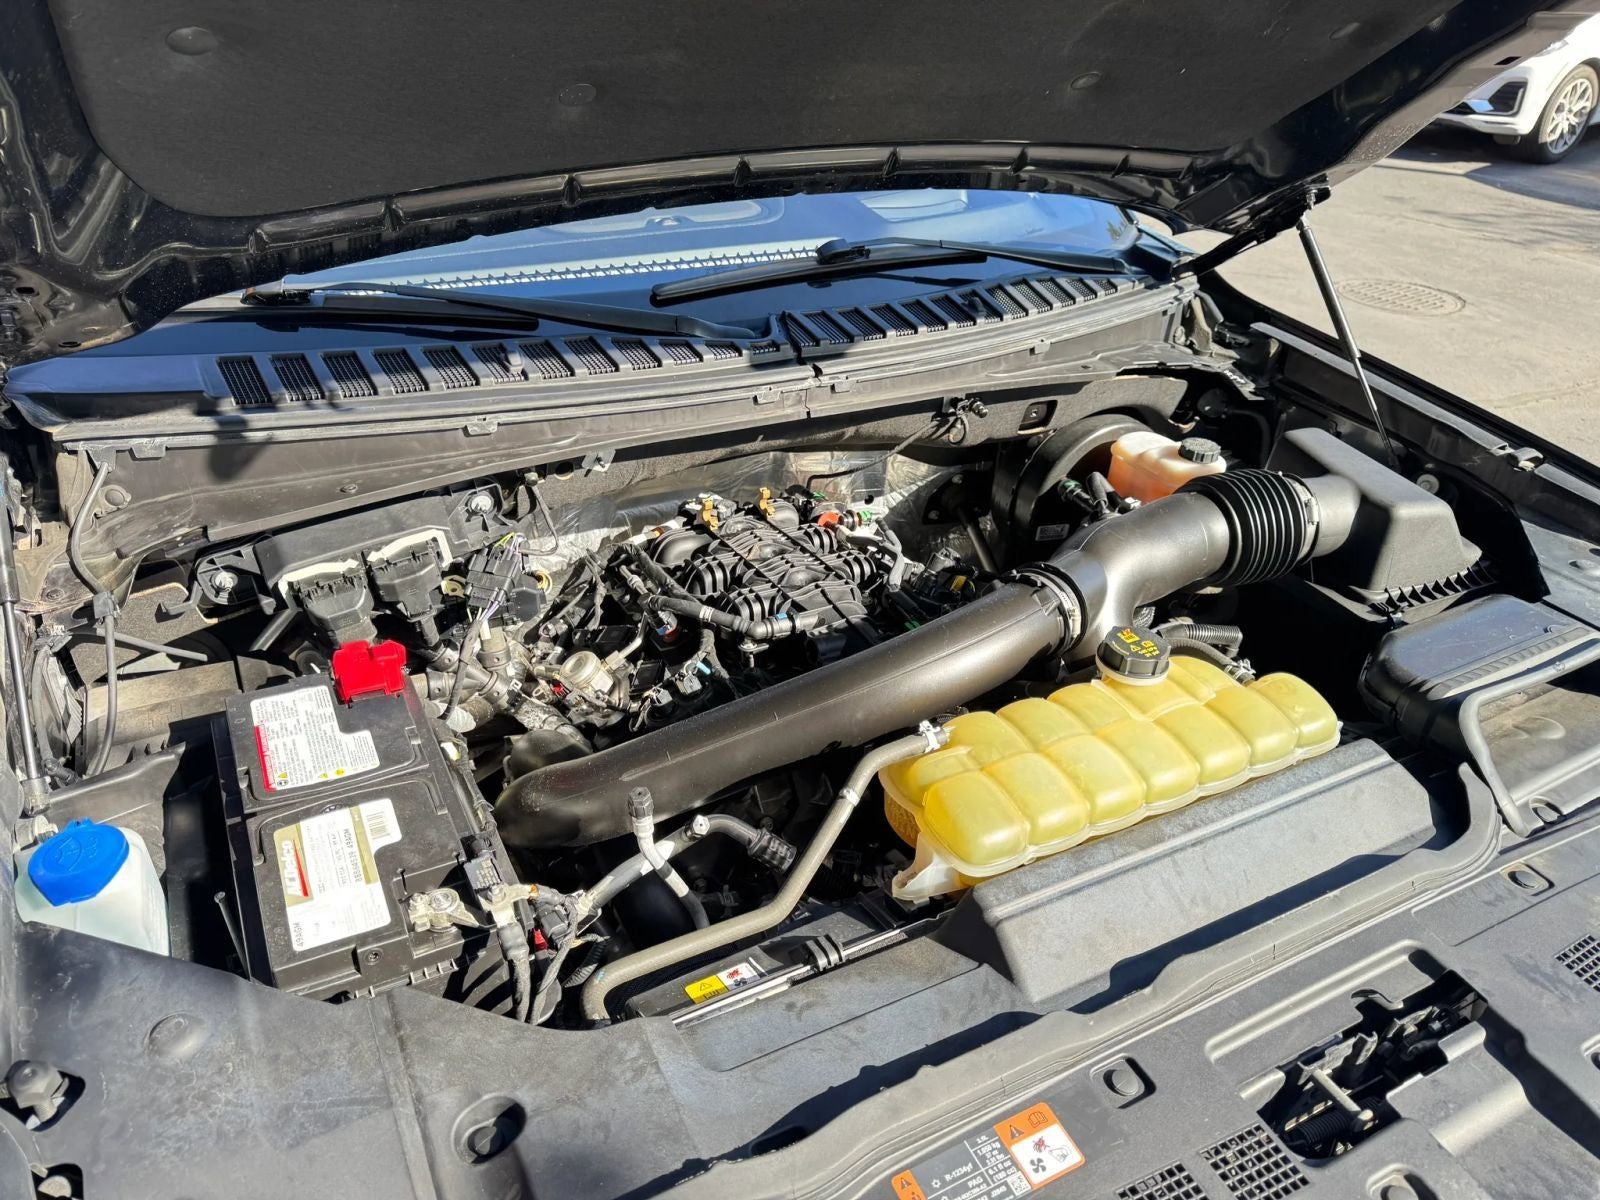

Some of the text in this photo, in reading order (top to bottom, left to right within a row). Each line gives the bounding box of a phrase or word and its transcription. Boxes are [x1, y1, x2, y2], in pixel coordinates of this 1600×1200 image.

[281, 839, 301, 896] ACDelco
[293, 921, 304, 948] 49AGM
[944, 1162, 973, 1182] R-1234yf
[967, 1176, 984, 1189] PAG
